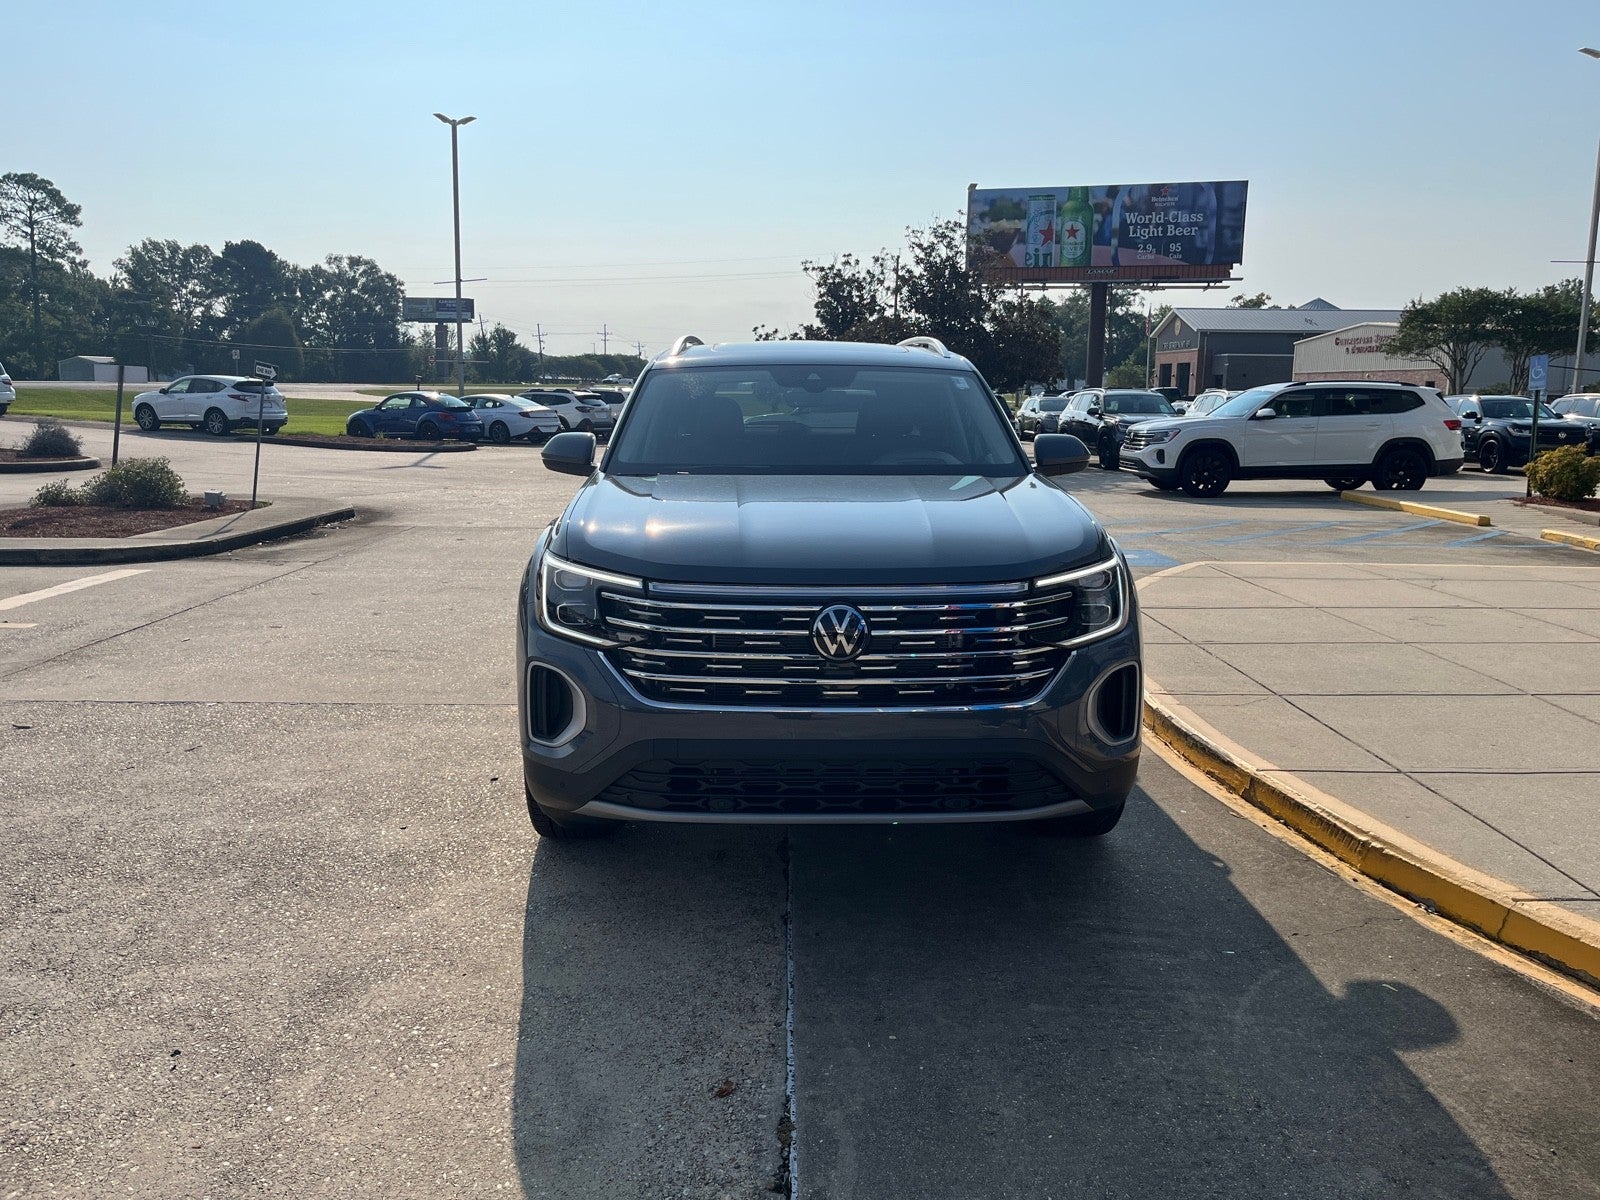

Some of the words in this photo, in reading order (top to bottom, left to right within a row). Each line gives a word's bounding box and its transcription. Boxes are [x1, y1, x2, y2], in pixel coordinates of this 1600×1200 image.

[1125, 211, 1204, 224] World-Class
[1128, 225, 1163, 240] Light
[1166, 225, 1199, 236] Beer
[1169, 243, 1182, 252] 95
